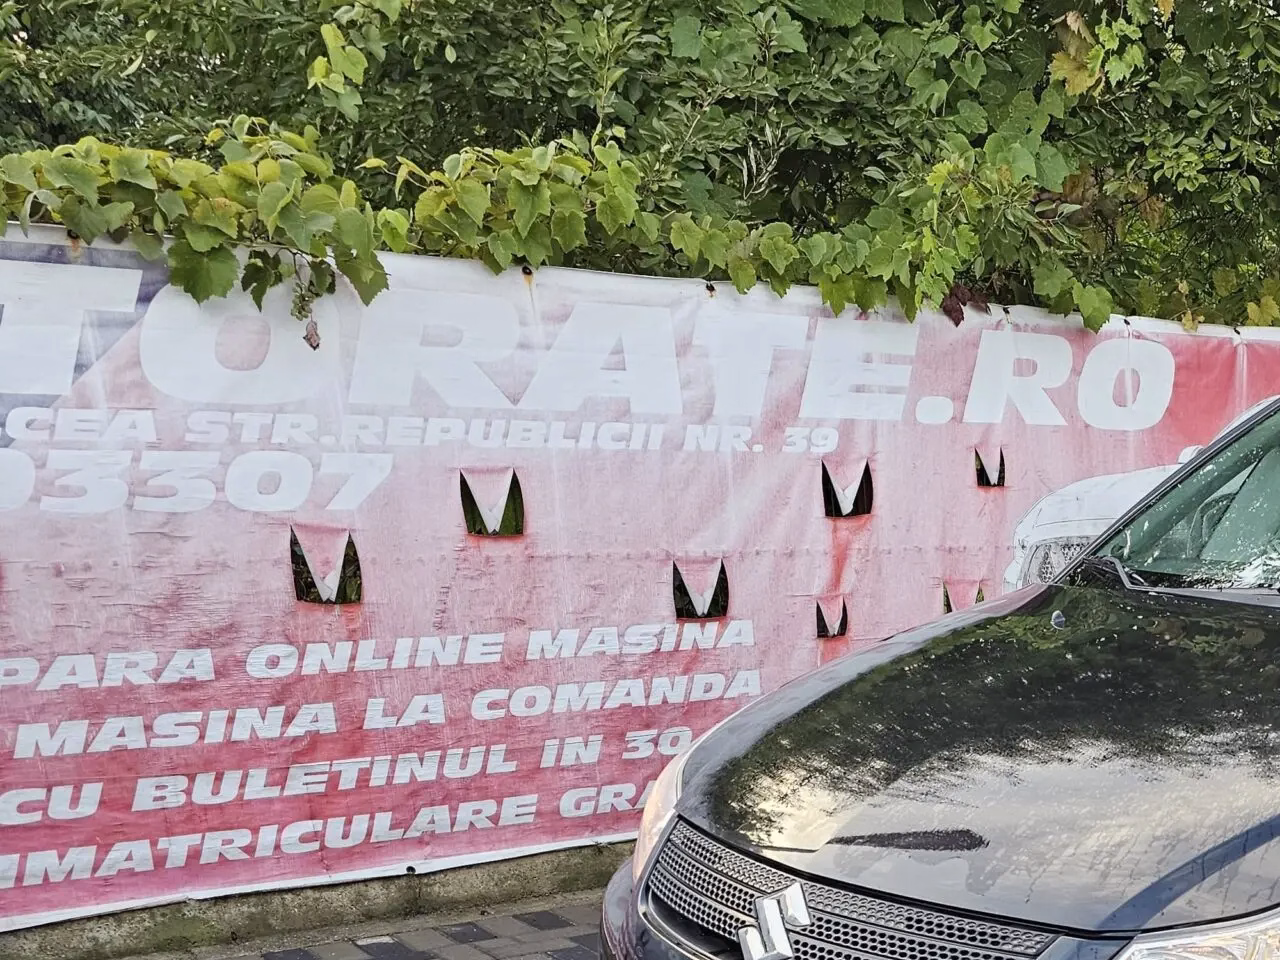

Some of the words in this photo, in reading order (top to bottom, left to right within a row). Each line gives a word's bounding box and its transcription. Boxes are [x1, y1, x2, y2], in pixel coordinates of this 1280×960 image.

[0, 406, 157, 444] CEA
[683, 424, 764, 453] NR.
[781, 426, 840, 454] 39
[0, 647, 216, 691] PARA
[246, 632, 504, 679] ONLINE
[525, 619, 756, 661] MASINA
[14, 701, 338, 759] MASINA
[363, 692, 446, 731] LA
[472, 669, 762, 721] COMANDA
[0, 782, 104, 826] CU
[132, 742, 518, 812] BULETINUL
[540, 734, 604, 769] IN
[621, 726, 693, 760] 30
